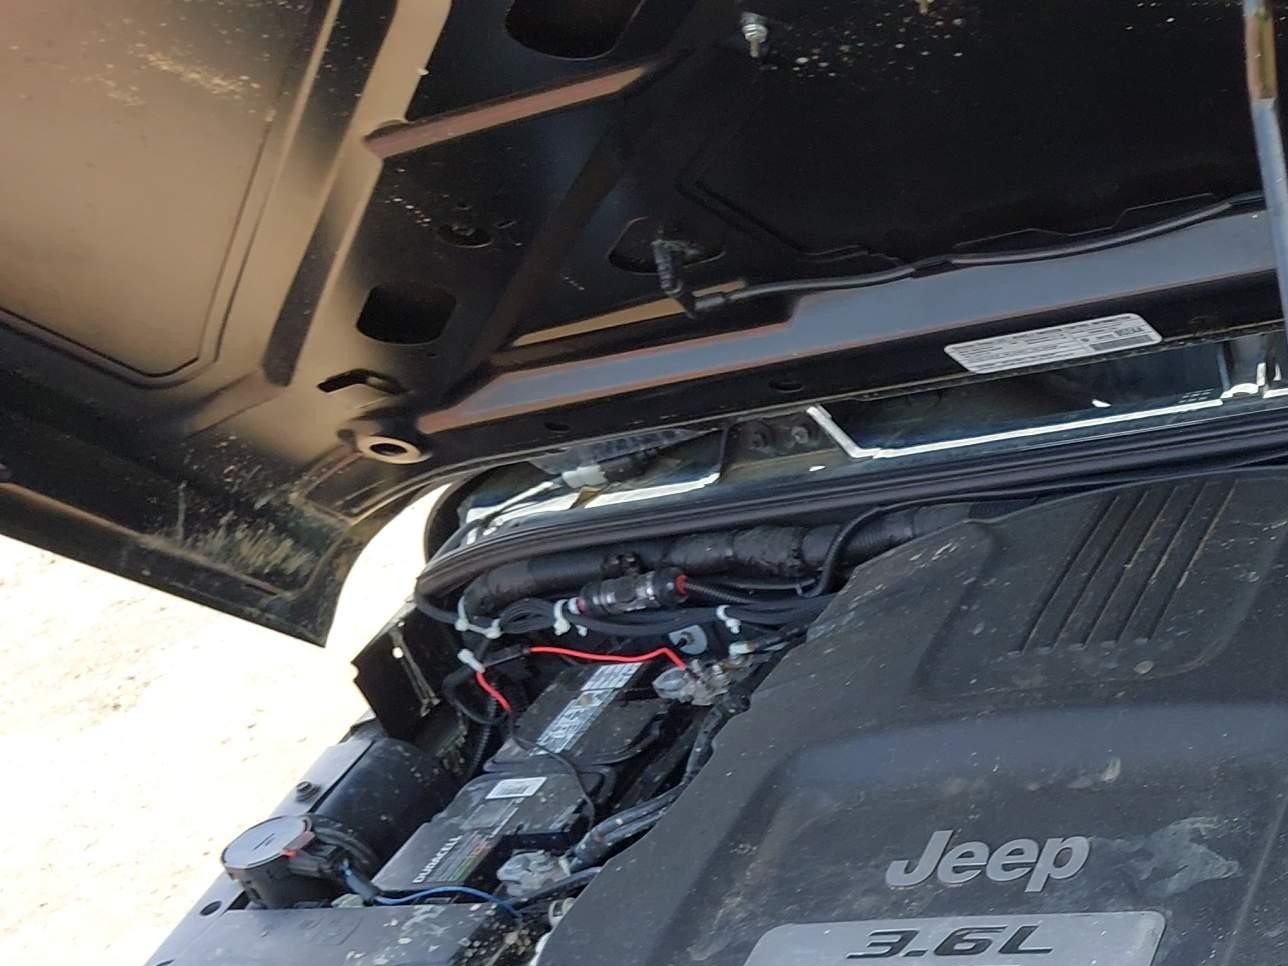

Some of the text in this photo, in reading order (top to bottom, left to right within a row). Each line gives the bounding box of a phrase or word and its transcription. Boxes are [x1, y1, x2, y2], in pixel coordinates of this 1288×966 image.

[412, 835, 464, 883] DURACELL
[885, 830, 1090, 893] Jeep
[847, 925, 1053, 959] 3.6L
